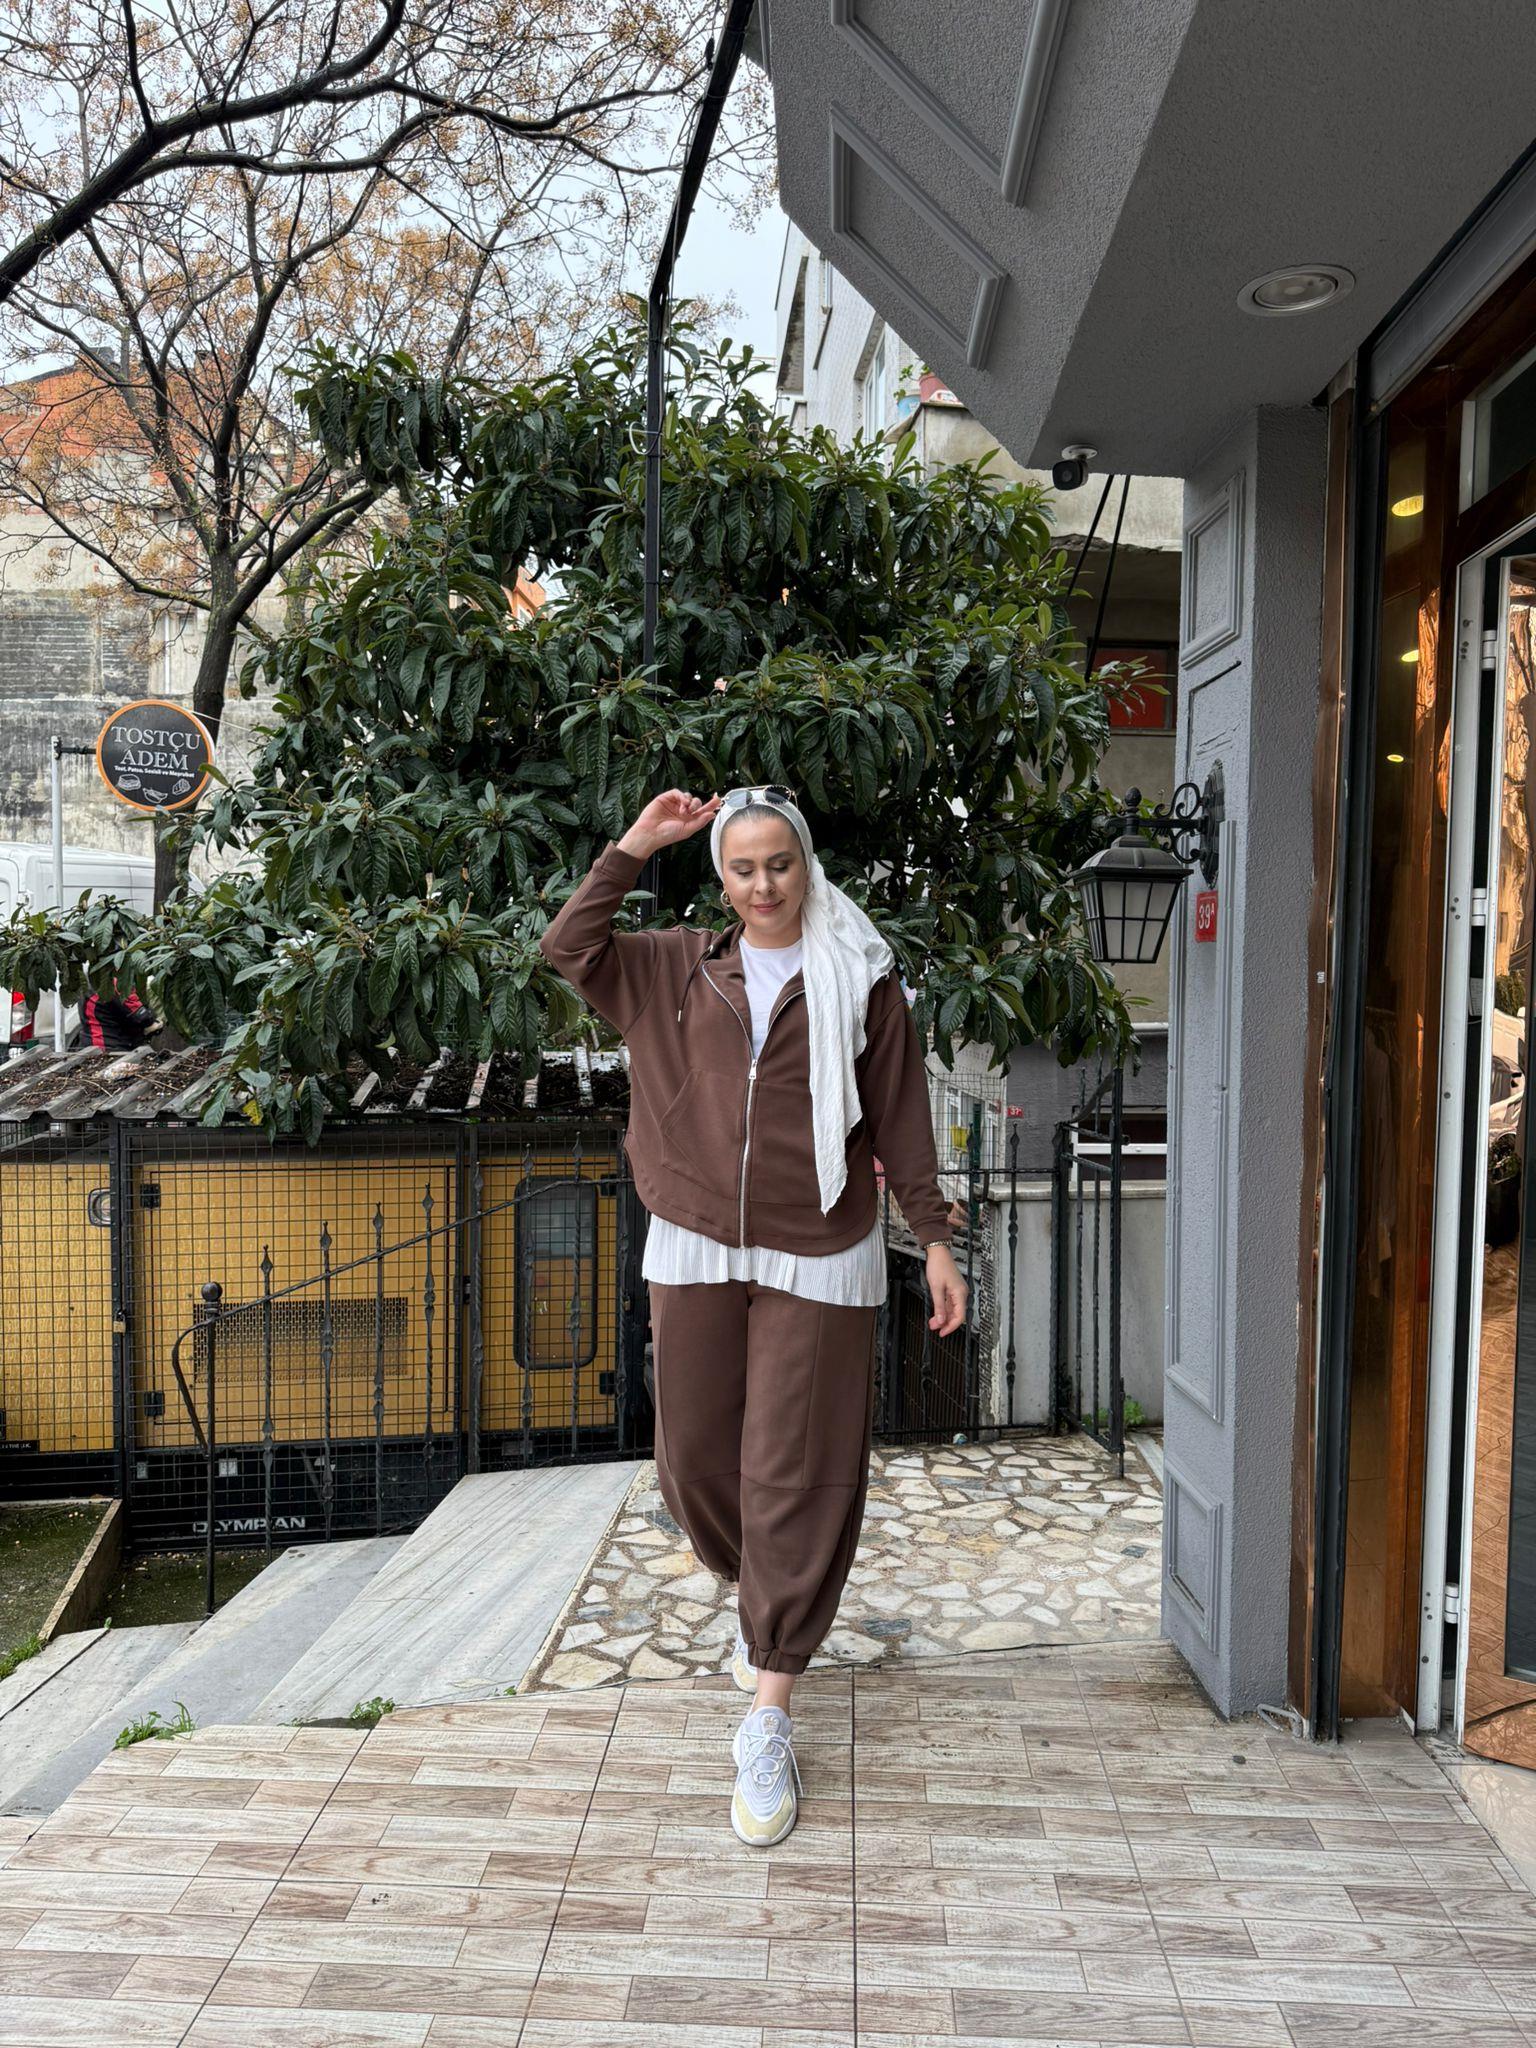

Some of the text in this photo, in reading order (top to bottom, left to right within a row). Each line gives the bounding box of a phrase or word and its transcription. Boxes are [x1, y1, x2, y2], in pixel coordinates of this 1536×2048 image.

[111, 726, 201, 752] TOSTÇU
[120, 749, 189, 770] ADEM
[192, 1517, 306, 1533] OYMPAN
